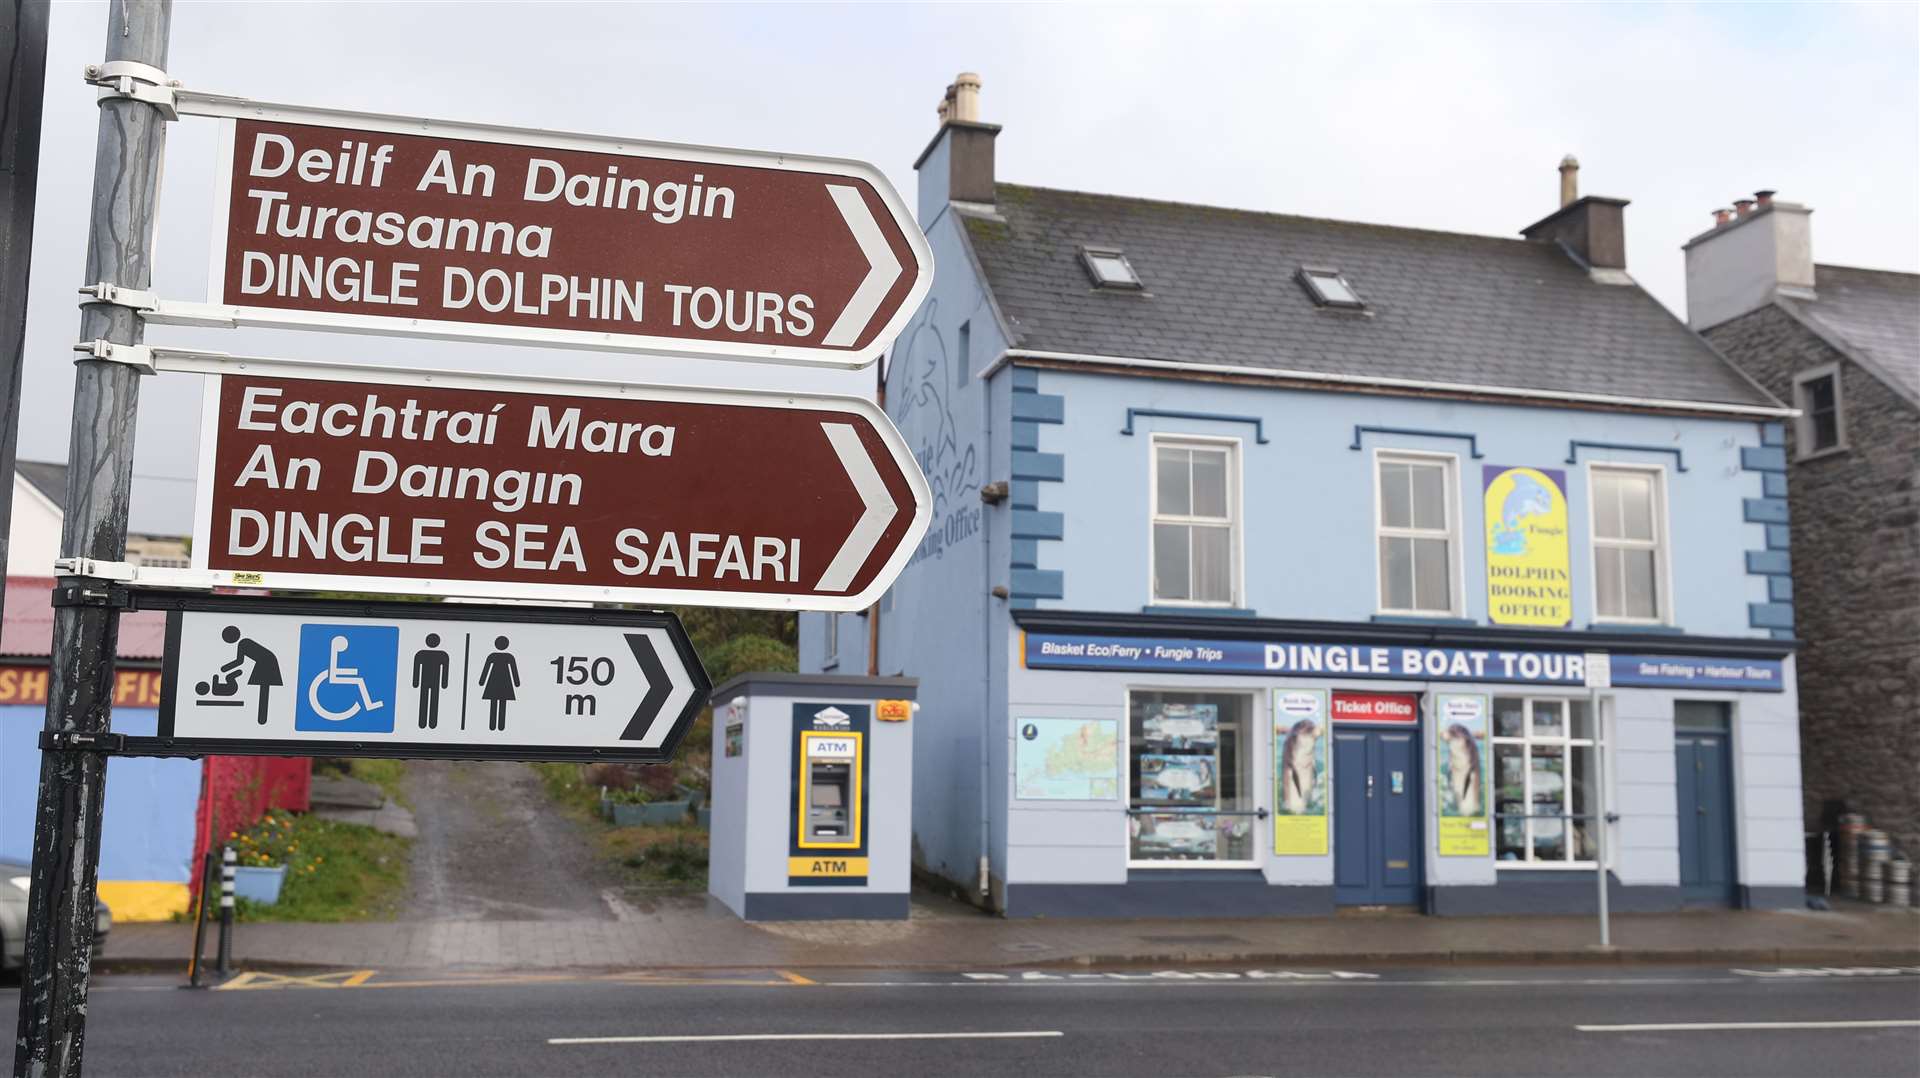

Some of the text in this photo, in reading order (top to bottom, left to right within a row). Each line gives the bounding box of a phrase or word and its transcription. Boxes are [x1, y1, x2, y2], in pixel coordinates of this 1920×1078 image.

[250, 133, 735, 224] Deilf An Daingin
[248, 189, 552, 258] Turasanna
[241, 251, 815, 337] DINGLE DOLPHIN TOURS
[238, 387, 675, 457] Eachtraí Mara
[234, 445, 321, 490] An
[945, 506, 980, 547] Office
[229, 509, 801, 583] DINGLE SEA SAFARI
[1490, 565, 1568, 580] DOLPHIN
[1491, 583, 1568, 598] BOOKING
[1499, 602, 1560, 617] OFFICE
[1041, 642, 1084, 656] Blasket
[1154, 646, 1193, 661] Fungie
[1196, 647, 1223, 661] Trips
[1263, 644, 1390, 673] DINGLE
[1402, 649, 1488, 676] BOAT
[550, 656, 615, 686] 150
[565, 694, 596, 715] m
[1334, 700, 1412, 715] Ticket Office
[817, 743, 847, 752] ATM
[812, 861, 847, 873] ATM
